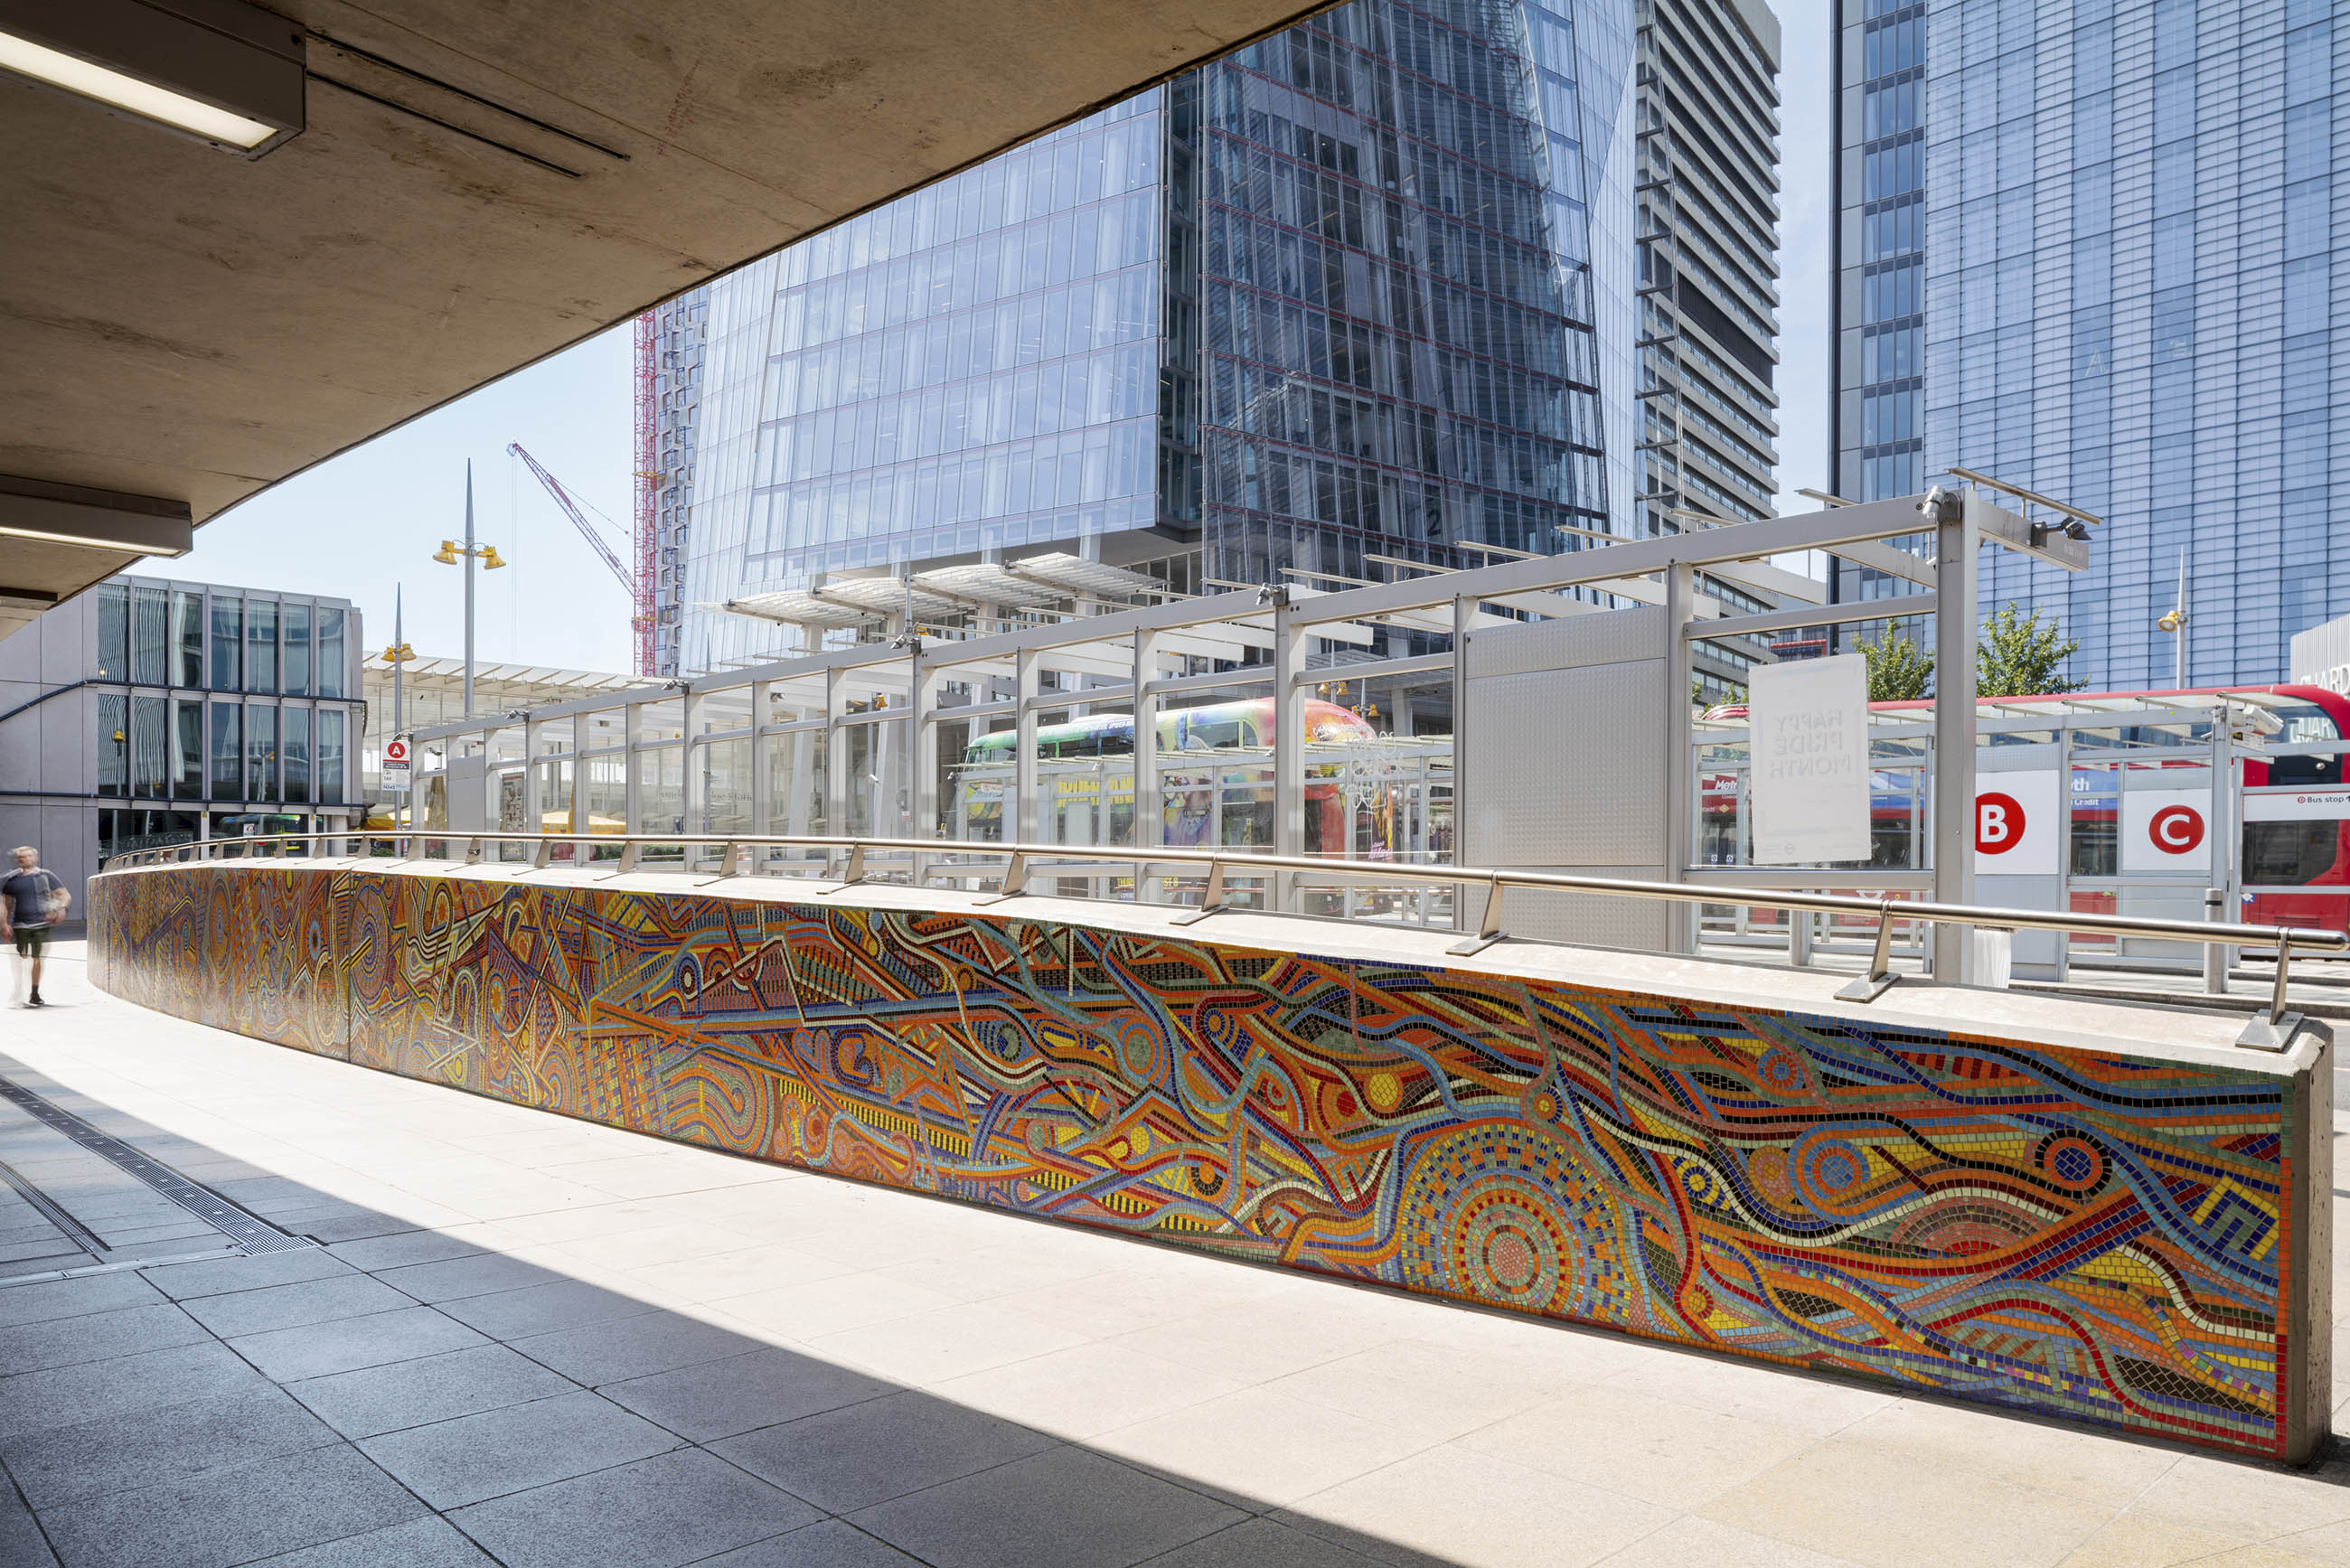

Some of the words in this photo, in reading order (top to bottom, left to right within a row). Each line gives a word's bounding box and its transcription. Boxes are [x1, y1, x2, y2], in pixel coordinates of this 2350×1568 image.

[391, 746, 402, 756] A
[1980, 804, 2008, 843] B
[2159, 813, 2190, 846] C
